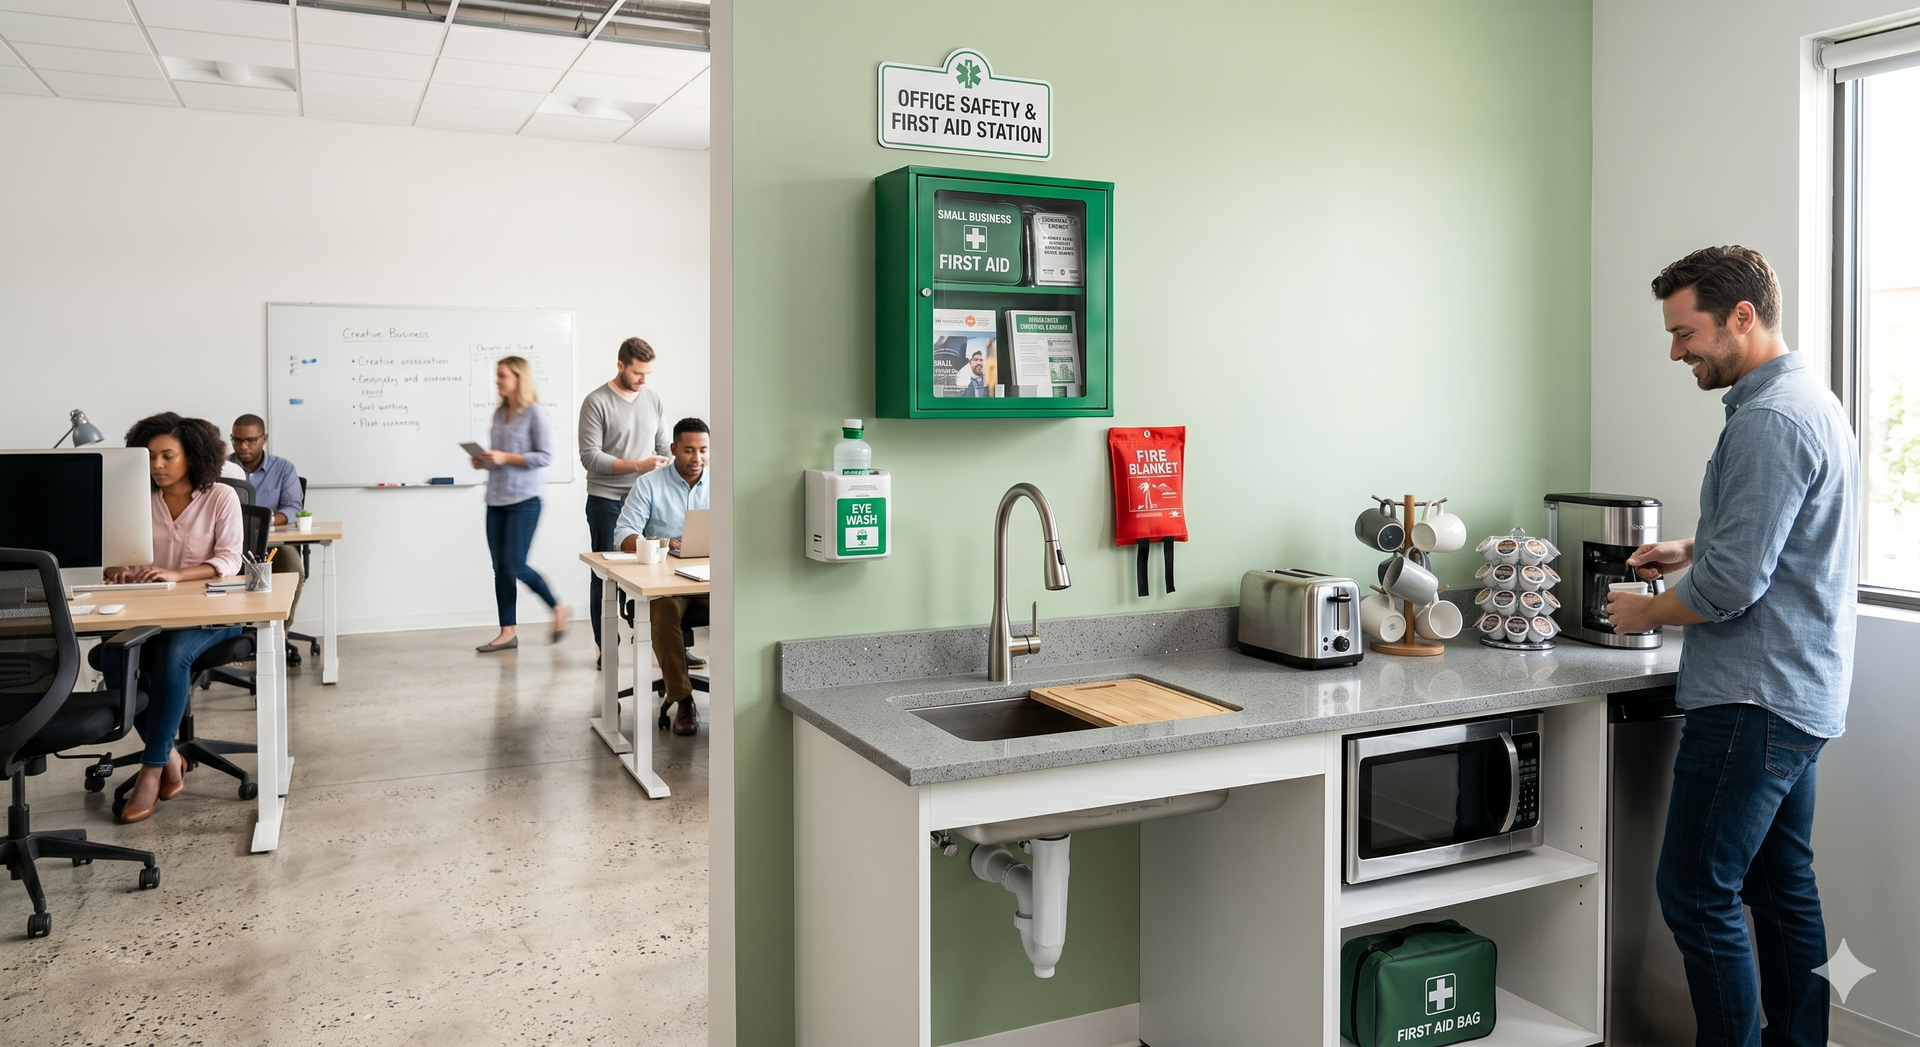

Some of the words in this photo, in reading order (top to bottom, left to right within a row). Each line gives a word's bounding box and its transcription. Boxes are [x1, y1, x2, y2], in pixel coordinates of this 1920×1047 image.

[898, 89, 955, 112] OFFICE
[960, 96, 1020, 118] SAFETY
[1024, 103, 1037, 120] &
[892, 112, 939, 133] FIRST
[944, 118, 971, 136] AID
[977, 121, 1042, 144] STATION
[938, 209, 967, 221] SMALL
[969, 212, 1012, 224] BUSINESS
[939, 254, 982, 271] FIRST
[985, 257, 1010, 273] AID
[342, 327, 383, 339] Creative
[389, 327, 430, 339] Business
[358, 356, 395, 366] Creative
[403, 374, 419, 383] and
[1136, 449, 1168, 463] FIRE
[1129, 462, 1179, 476] BLANKET
[852, 503, 872, 514] EYE
[845, 514, 878, 525] WASH
[1397, 1023, 1432, 1042] FIRST
[1433, 1018, 1454, 1035] AID
[1457, 1011, 1481, 1029] BAG
